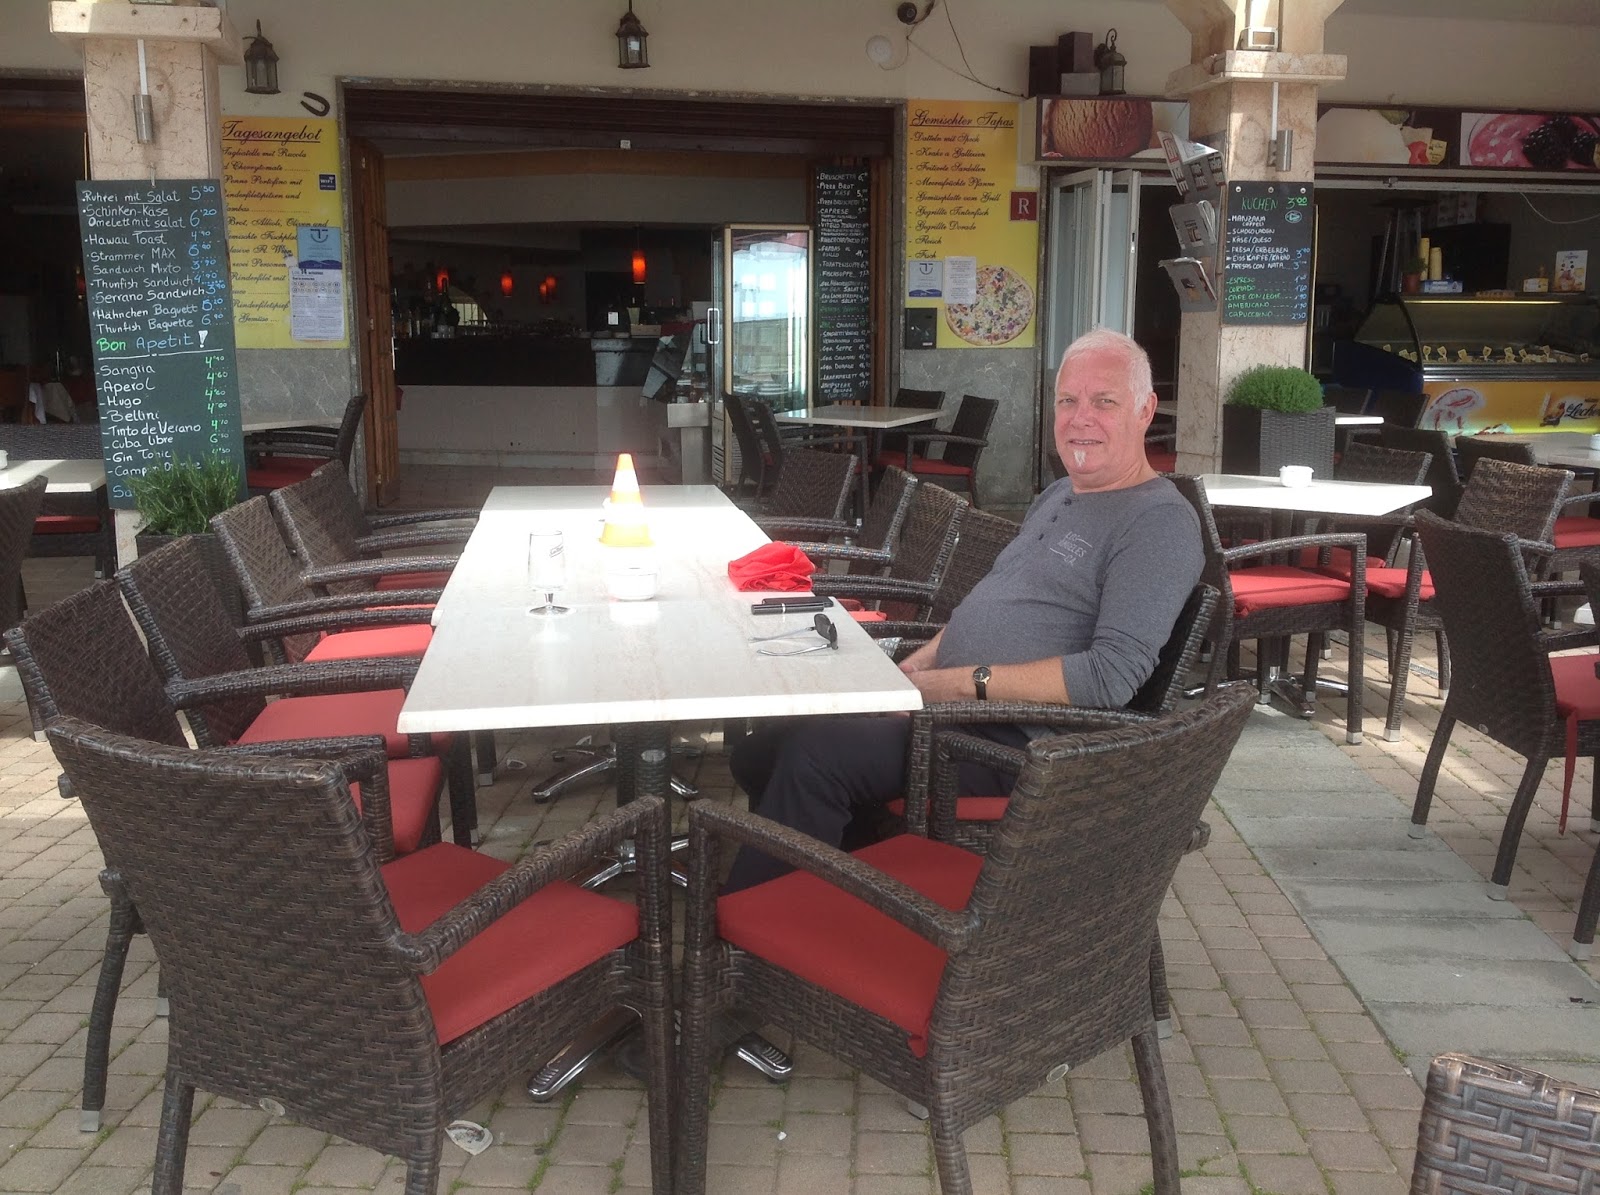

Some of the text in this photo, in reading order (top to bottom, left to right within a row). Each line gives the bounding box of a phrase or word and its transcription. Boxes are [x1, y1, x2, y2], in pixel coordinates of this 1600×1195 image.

[912, 109, 1014, 129] Gemischter Tapas
[222, 121, 321, 145] Tagesangebot
[278, 148, 306, 157] Rucola
[224, 175, 248, 185] Penne
[968, 177, 995, 189] Pfanne
[147, 191, 180, 203] Salat
[1018, 198, 1030, 214] R
[950, 207, 989, 218] Tintenfisch
[132, 218, 150, 227] mit
[949, 221, 976, 230] Dorade
[132, 232, 167, 244] Toast
[91, 253, 144, 262] Strammer
[152, 248, 176, 259] MAX
[915, 250, 936, 258] Fisch
[93, 263, 145, 275] Sandwich
[151, 263, 181, 273] Mixto
[144, 275, 193, 287] Sandwich
[95, 293, 143, 304] Serrano
[147, 288, 205, 301] Sandwich
[148, 319, 193, 331] Baguette
[96, 338, 126, 352] Bon
[136, 333, 194, 352] Apetit
[100, 365, 155, 379] Sangria
[107, 396, 141, 408] Hugo
[107, 410, 159, 422] Bellini
[108, 426, 138, 437] Tinto
[141, 423, 157, 435] de
[158, 421, 201, 434] Verano
[112, 438, 141, 449] Cuba
[113, 452, 132, 462] Gin
